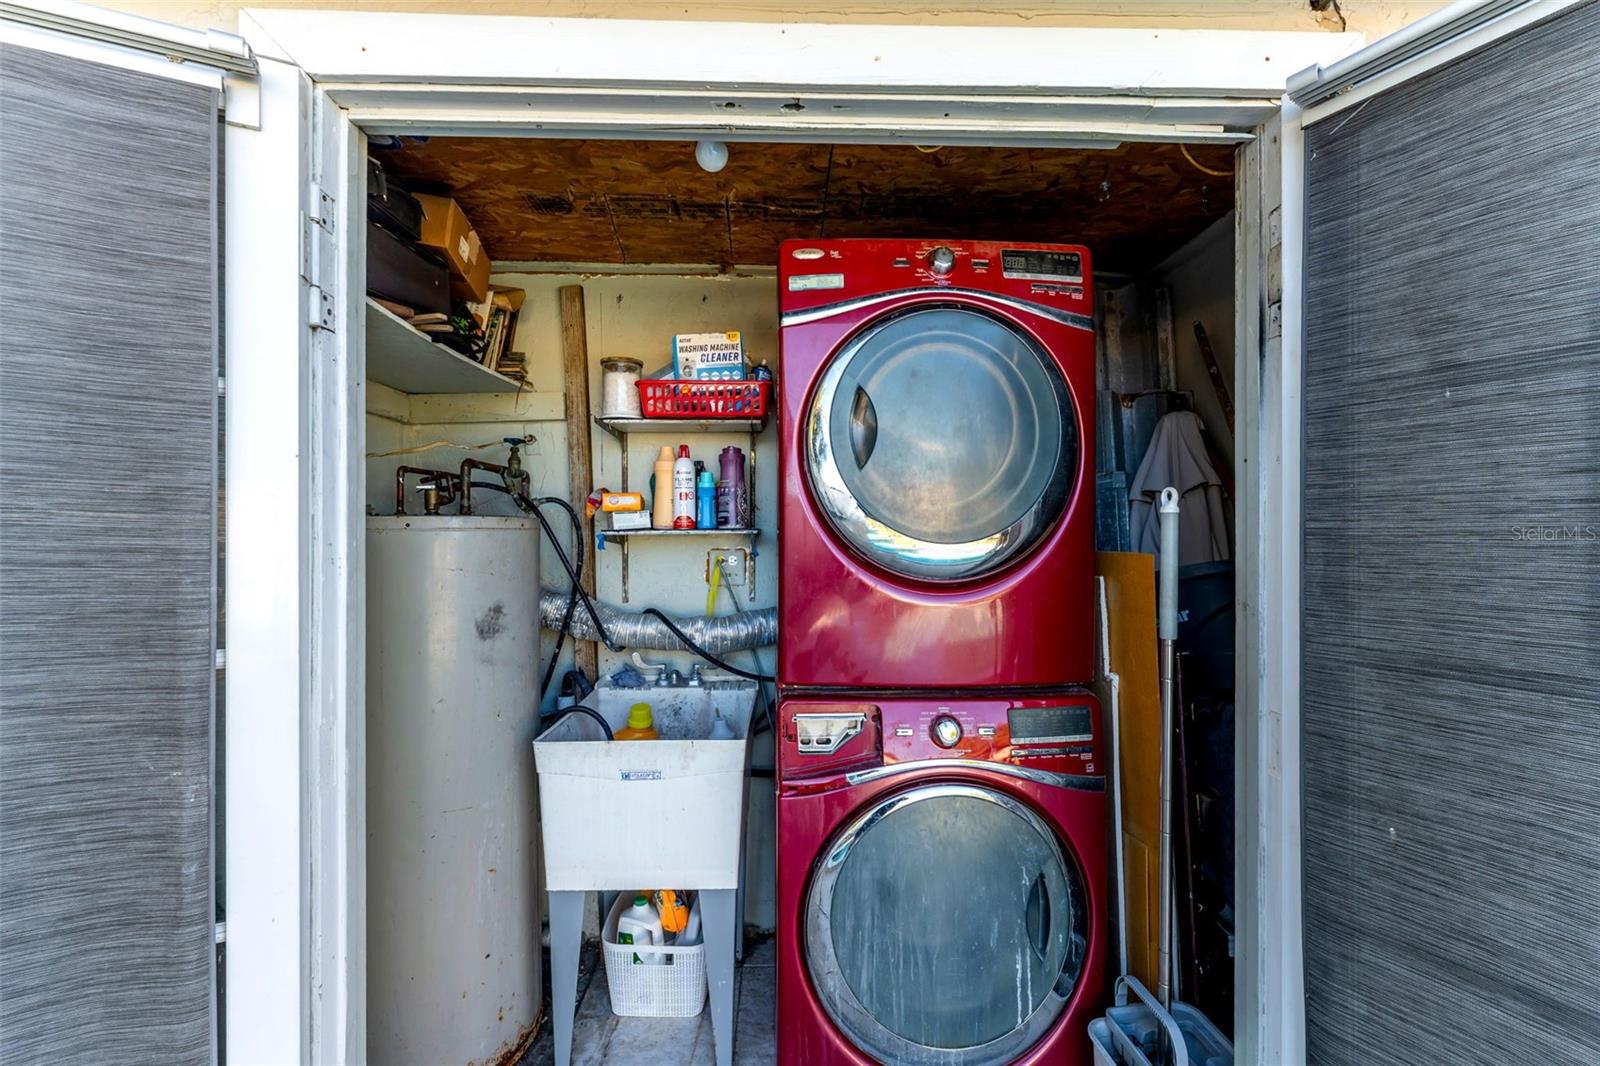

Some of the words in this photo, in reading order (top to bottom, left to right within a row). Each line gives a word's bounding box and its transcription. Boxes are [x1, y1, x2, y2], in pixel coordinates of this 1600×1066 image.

[679, 344, 708, 353] WASHING
[710, 343, 740, 352] MACHINE
[700, 352, 740, 363] CLEANER
